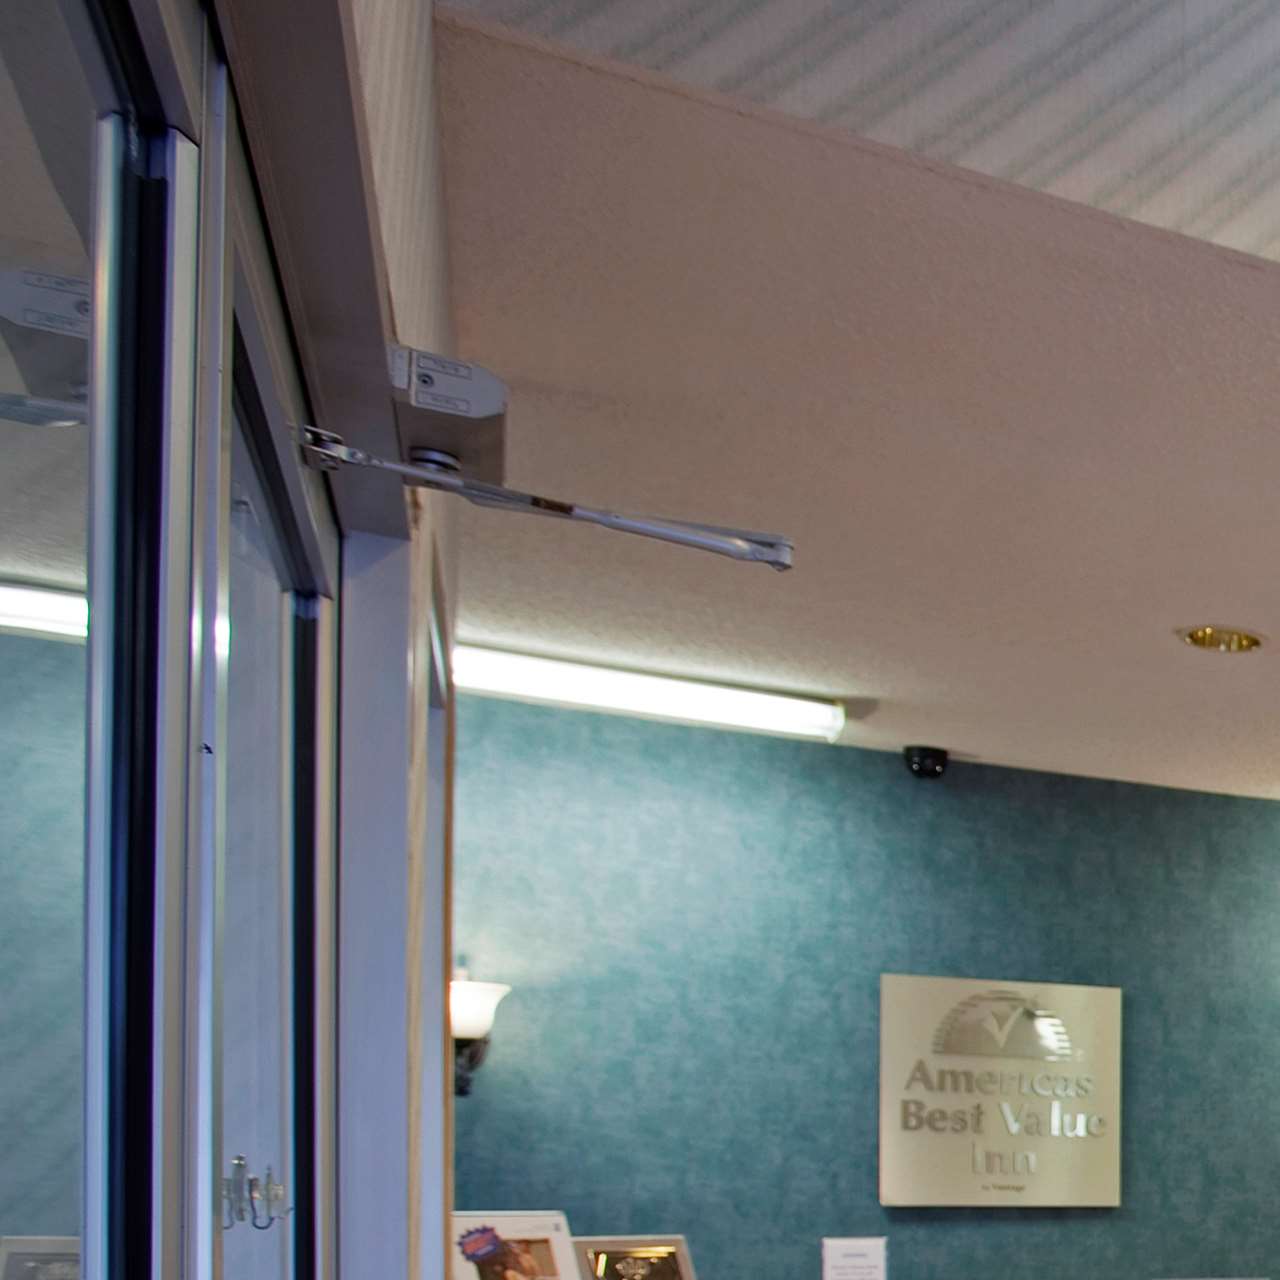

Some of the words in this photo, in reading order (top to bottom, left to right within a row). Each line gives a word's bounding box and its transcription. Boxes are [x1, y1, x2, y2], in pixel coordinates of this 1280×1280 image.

[901, 1099, 984, 1135] Best
[1000, 1100, 1106, 1138] Value
[971, 1141, 1037, 1176] Inn
